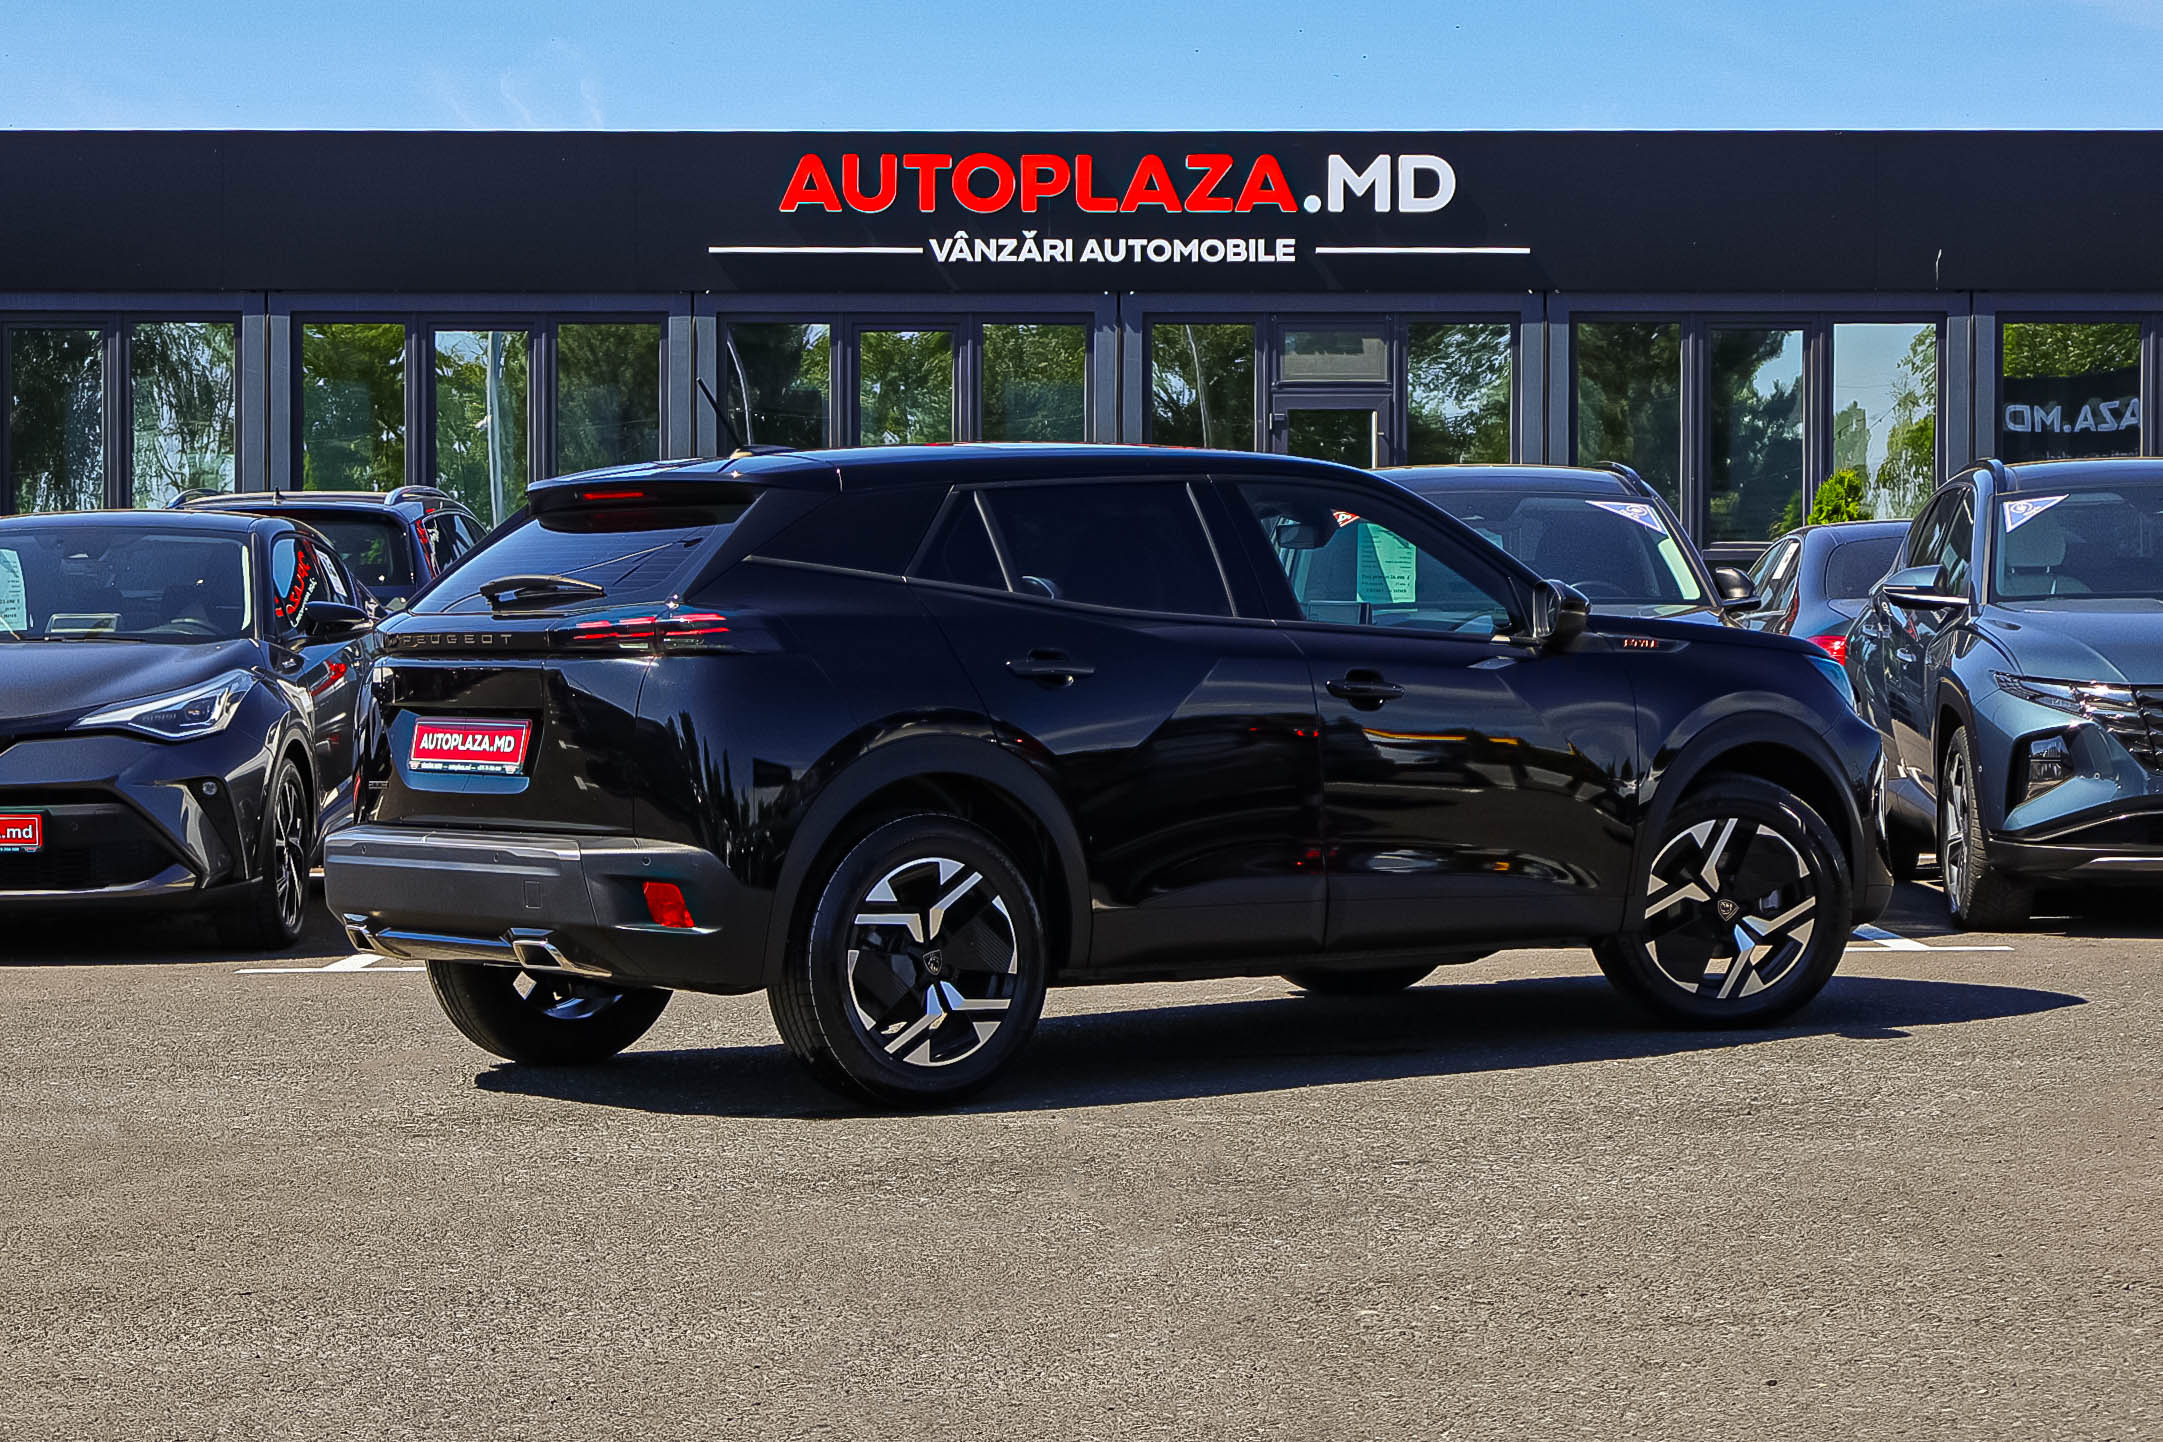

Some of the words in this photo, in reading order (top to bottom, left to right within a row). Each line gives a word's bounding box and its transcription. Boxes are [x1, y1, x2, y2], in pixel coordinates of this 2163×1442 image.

[778, 152, 1456, 214] AUTOPLAZA.MD
[929, 230, 1073, 263] VÂNZĂRI
[1079, 238, 1296, 263] AUTOMOBILE
[402, 634, 512, 645] PEUGEOT
[420, 733, 515, 753] AUTOPLAZA.MD
[0, 824, 33, 839] .md
